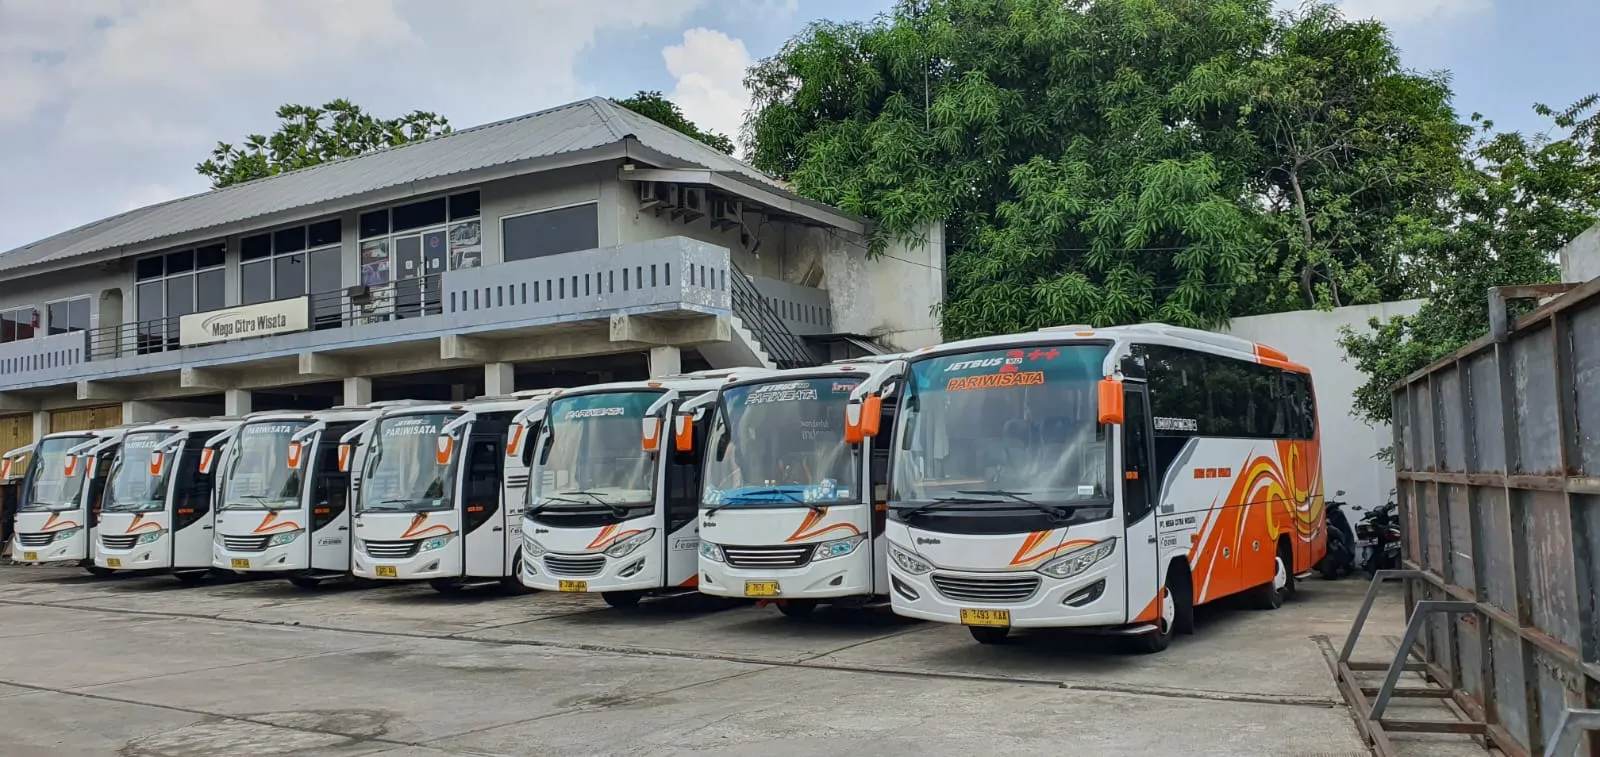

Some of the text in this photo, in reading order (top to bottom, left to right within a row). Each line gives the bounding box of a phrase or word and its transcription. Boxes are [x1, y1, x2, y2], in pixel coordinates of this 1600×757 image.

[212, 313, 287, 337] Mega Citra Wisata
[944, 357, 1004, 372] JETBUS
[946, 371, 1045, 392] PARIWISATA
[744, 389, 818, 405] PARIWISATA
[385, 425, 437, 438] PARIWISATA
[961, 609, 968, 618] B
